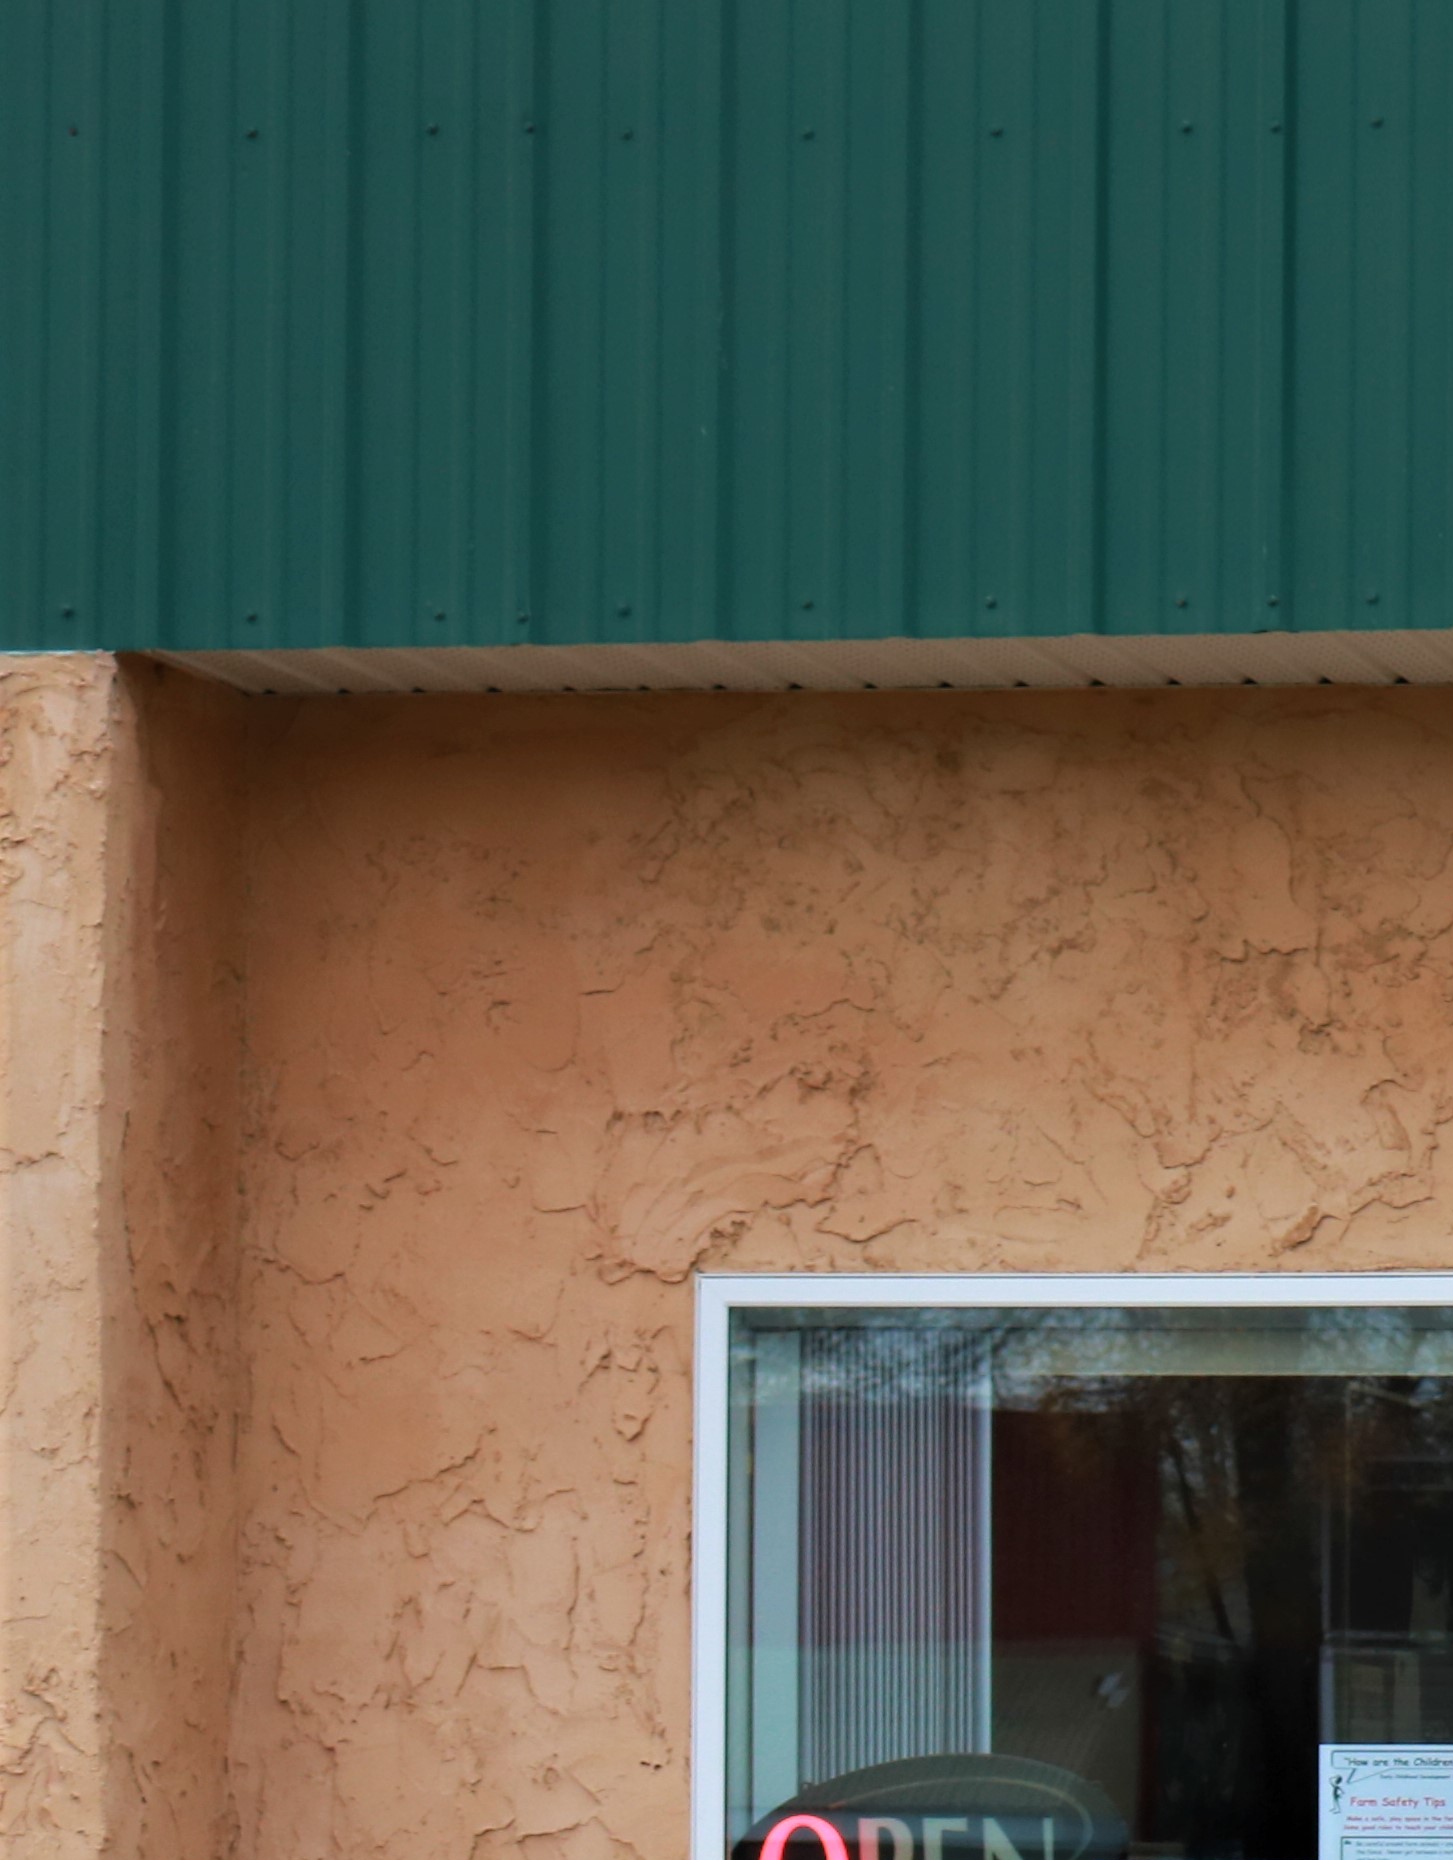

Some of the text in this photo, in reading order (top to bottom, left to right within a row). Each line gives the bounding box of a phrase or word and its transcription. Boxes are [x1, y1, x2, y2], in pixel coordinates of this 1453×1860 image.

[1394, 1758, 1409, 1766] the
[1350, 1797, 1445, 1808] Farm Safety Tips
